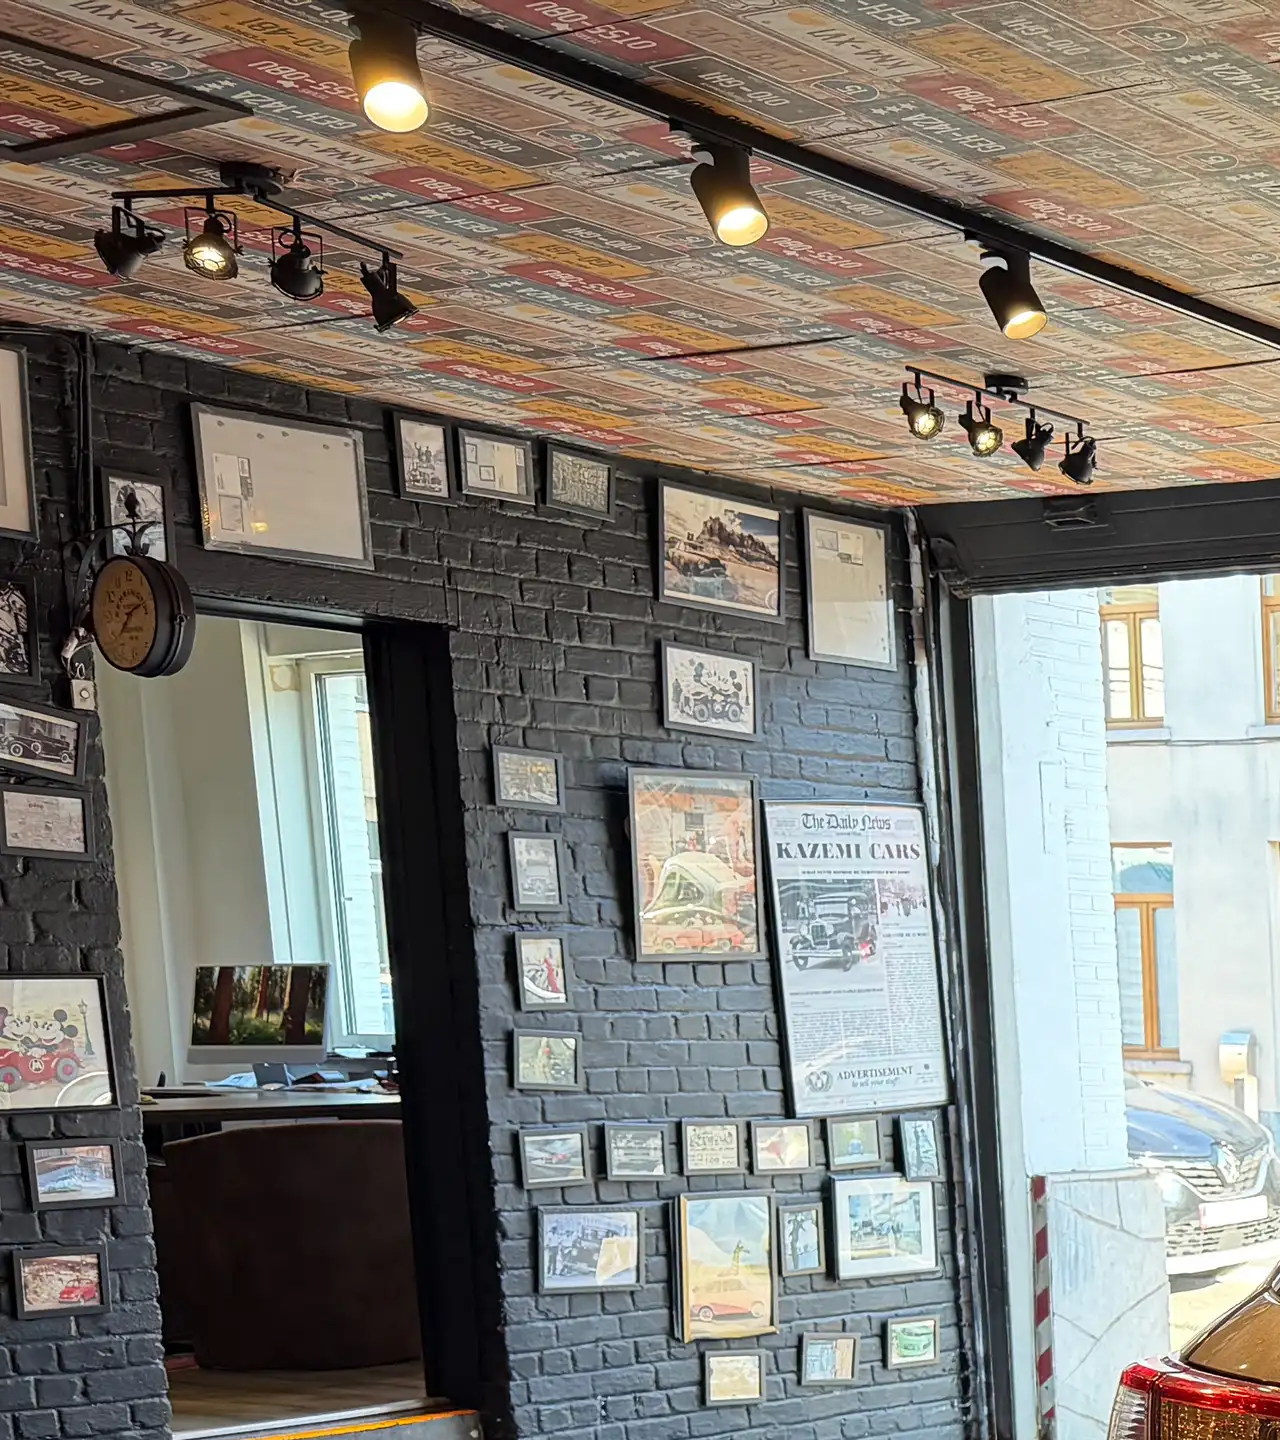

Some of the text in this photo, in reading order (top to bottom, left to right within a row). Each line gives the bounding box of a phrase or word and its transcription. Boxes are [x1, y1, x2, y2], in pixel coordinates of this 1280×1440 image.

[801, 812, 825, 831] The
[825, 813, 859, 831] Daily
[860, 814, 892, 832] News
[775, 842, 921, 861] KAZEMI CARS
[836, 1065, 914, 1081] ADVERTISEMENT
